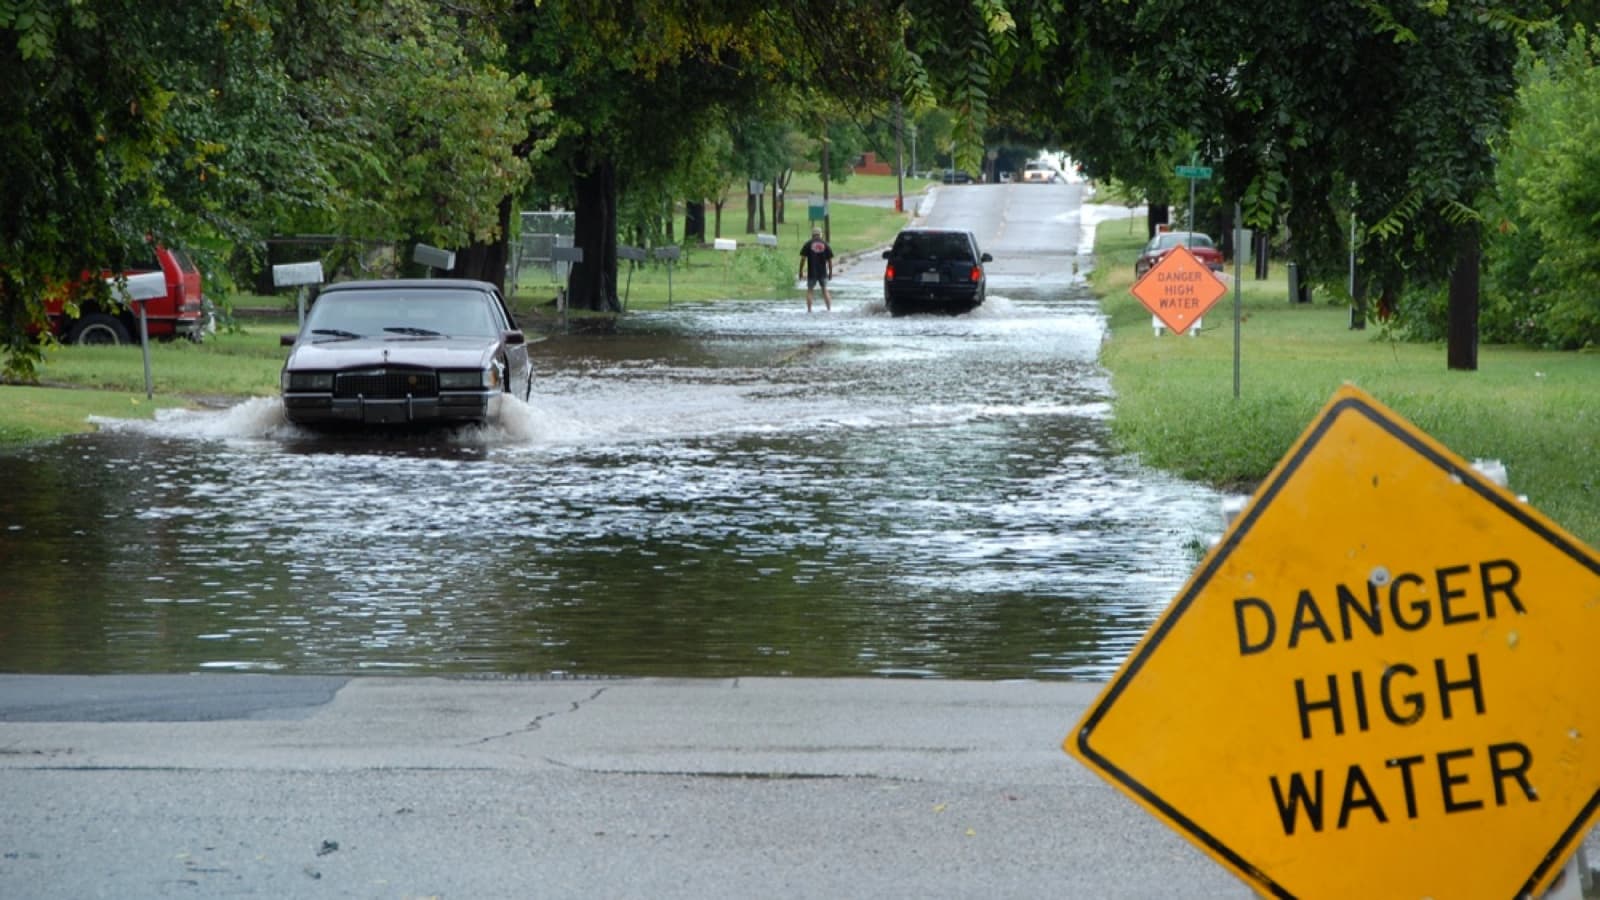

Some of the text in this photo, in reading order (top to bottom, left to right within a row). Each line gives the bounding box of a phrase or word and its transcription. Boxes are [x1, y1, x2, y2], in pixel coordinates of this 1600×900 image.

[1158, 271, 1202, 282] DANGER
[1165, 285, 1194, 296] HIGH
[1159, 298, 1199, 309] WATER
[1233, 558, 1526, 656] DANGER
[1294, 653, 1486, 740] HIGH
[1269, 741, 1539, 836] WATER
